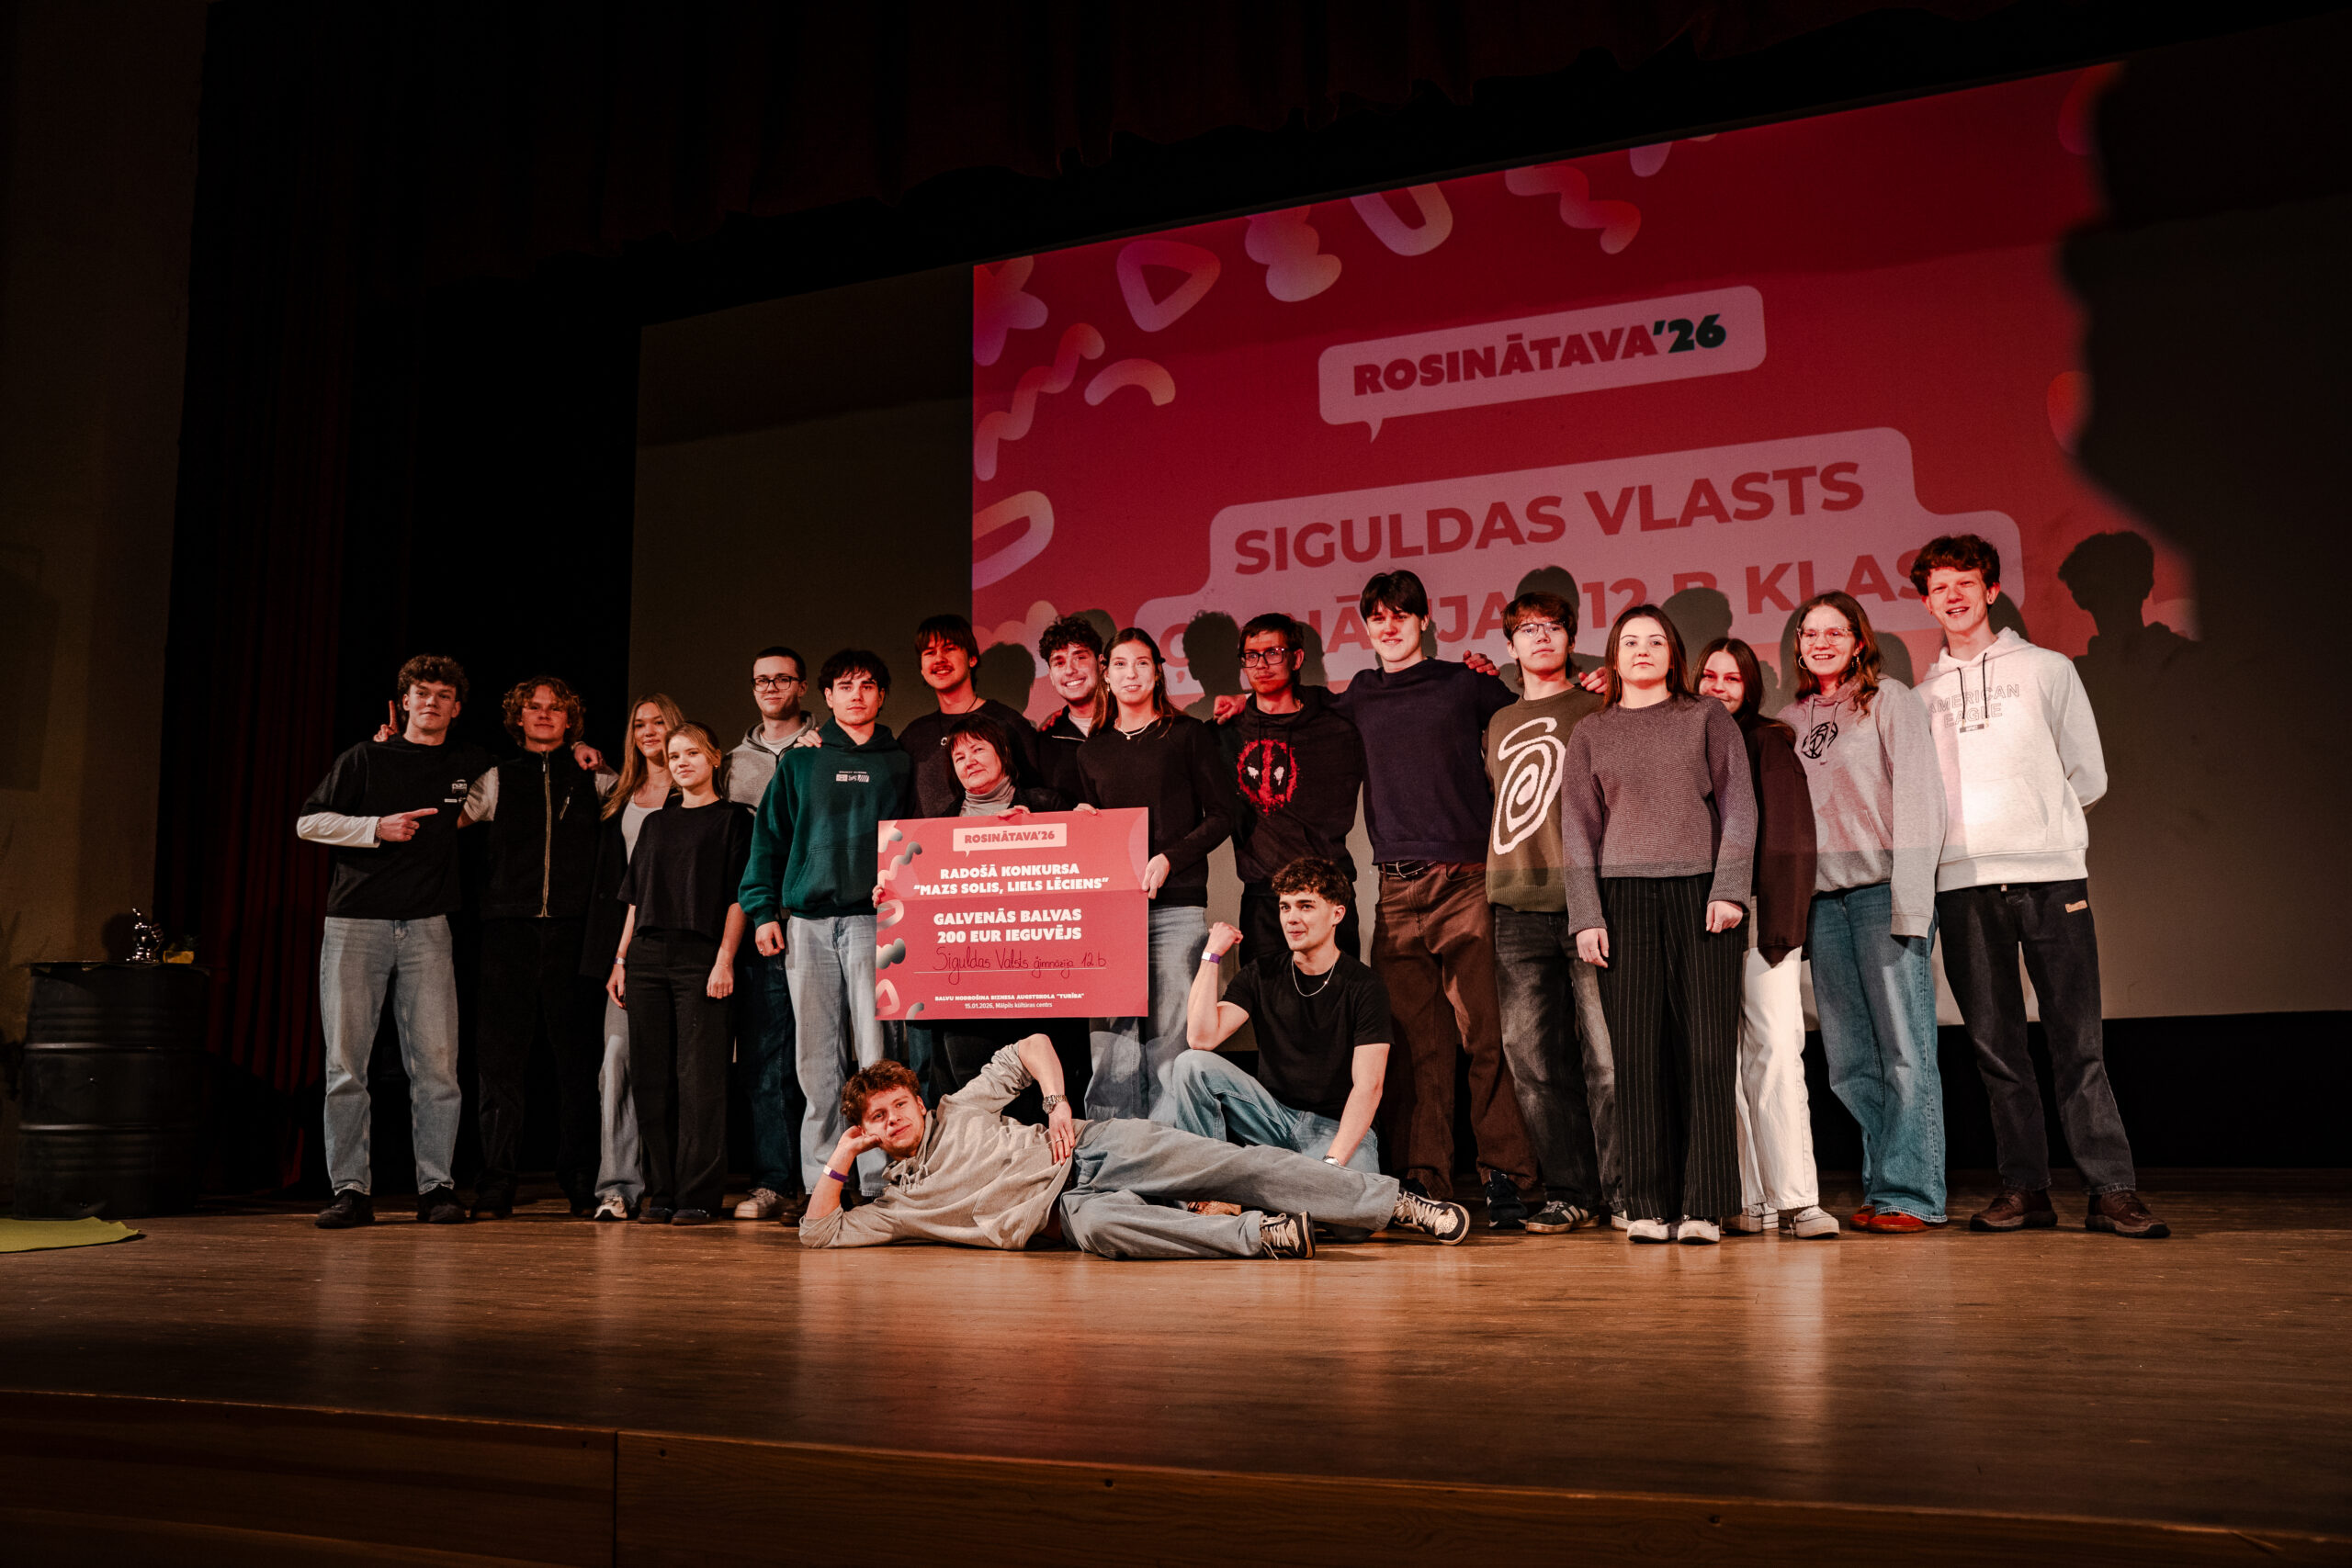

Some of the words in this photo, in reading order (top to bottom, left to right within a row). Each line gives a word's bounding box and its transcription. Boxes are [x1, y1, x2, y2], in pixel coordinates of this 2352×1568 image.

[1353, 314, 1726, 396] ROSINĀTAVA'26
[1234, 496, 1566, 575] SIGULDAS
[1583, 461, 1864, 536] VLASTS
[1928, 683, 2019, 714] AMERICAN
[1943, 703, 2003, 728] EAGLE
[965, 830, 1055, 843] ROSINĀTAVA'26
[940, 863, 998, 880] RADOŠĀ
[1001, 863, 1080, 877] KONKURSA
[913, 884, 957, 896] "MAZS
[961, 882, 1003, 895] SOLIS,
[1007, 880, 1043, 892] LIELS
[1046, 876, 1109, 891] LĒCIENS"
[933, 908, 1016, 926] GALVENĀS
[1020, 908, 1082, 922] BALVAS
[937, 931, 967, 943] 200
[970, 930, 1001, 942] EUR
[1005, 924, 1082, 942] IEGUVĒJS
[933, 946, 990, 985] Siguldas
[995, 947, 1028, 969] Valsts
